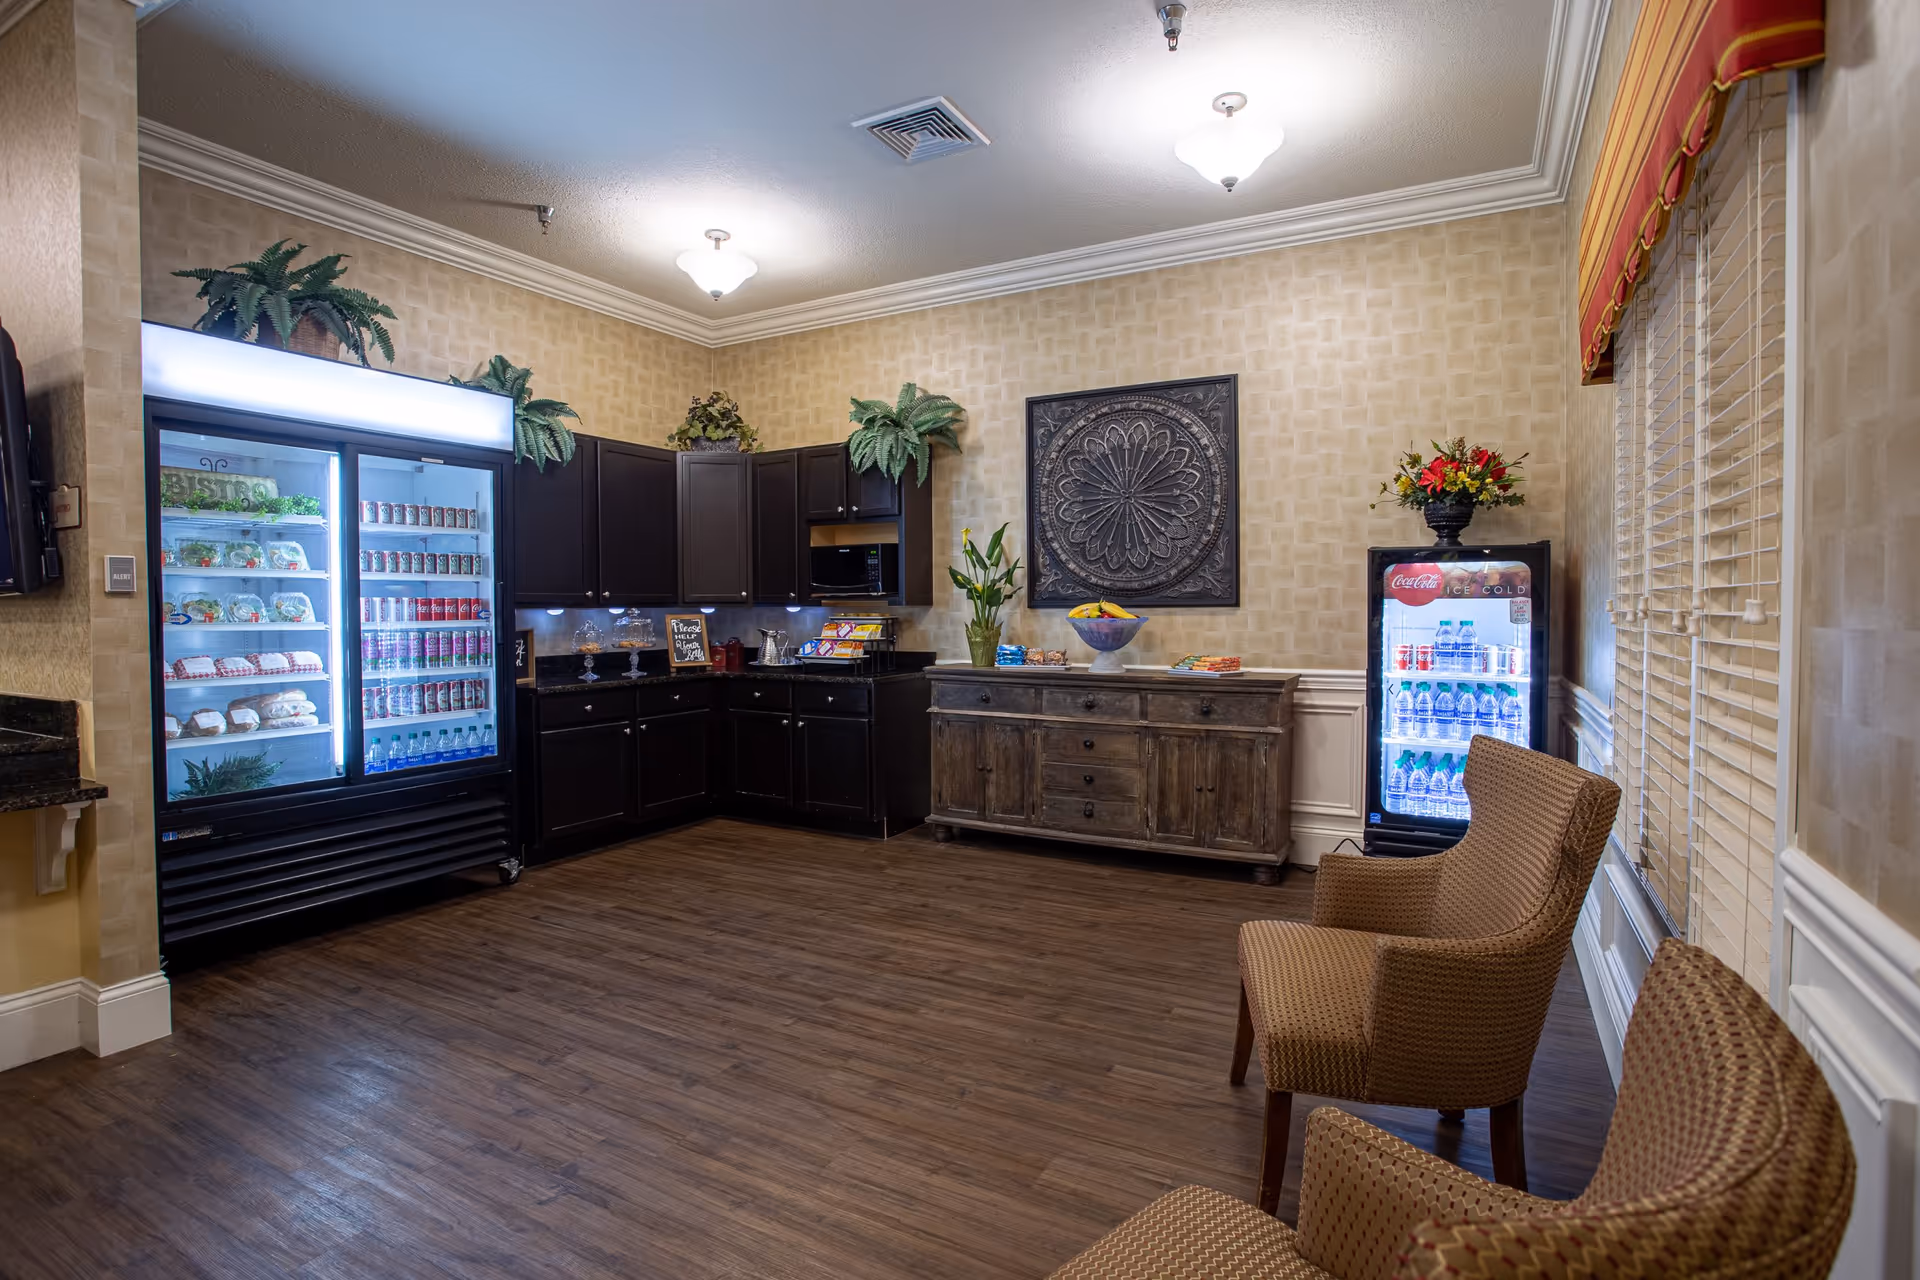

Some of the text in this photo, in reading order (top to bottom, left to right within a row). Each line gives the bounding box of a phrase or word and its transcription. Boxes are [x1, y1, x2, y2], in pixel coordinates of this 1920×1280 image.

[1391, 573, 1441, 589] Coca-Cola
[1446, 585, 1526, 595] ICE COLD
